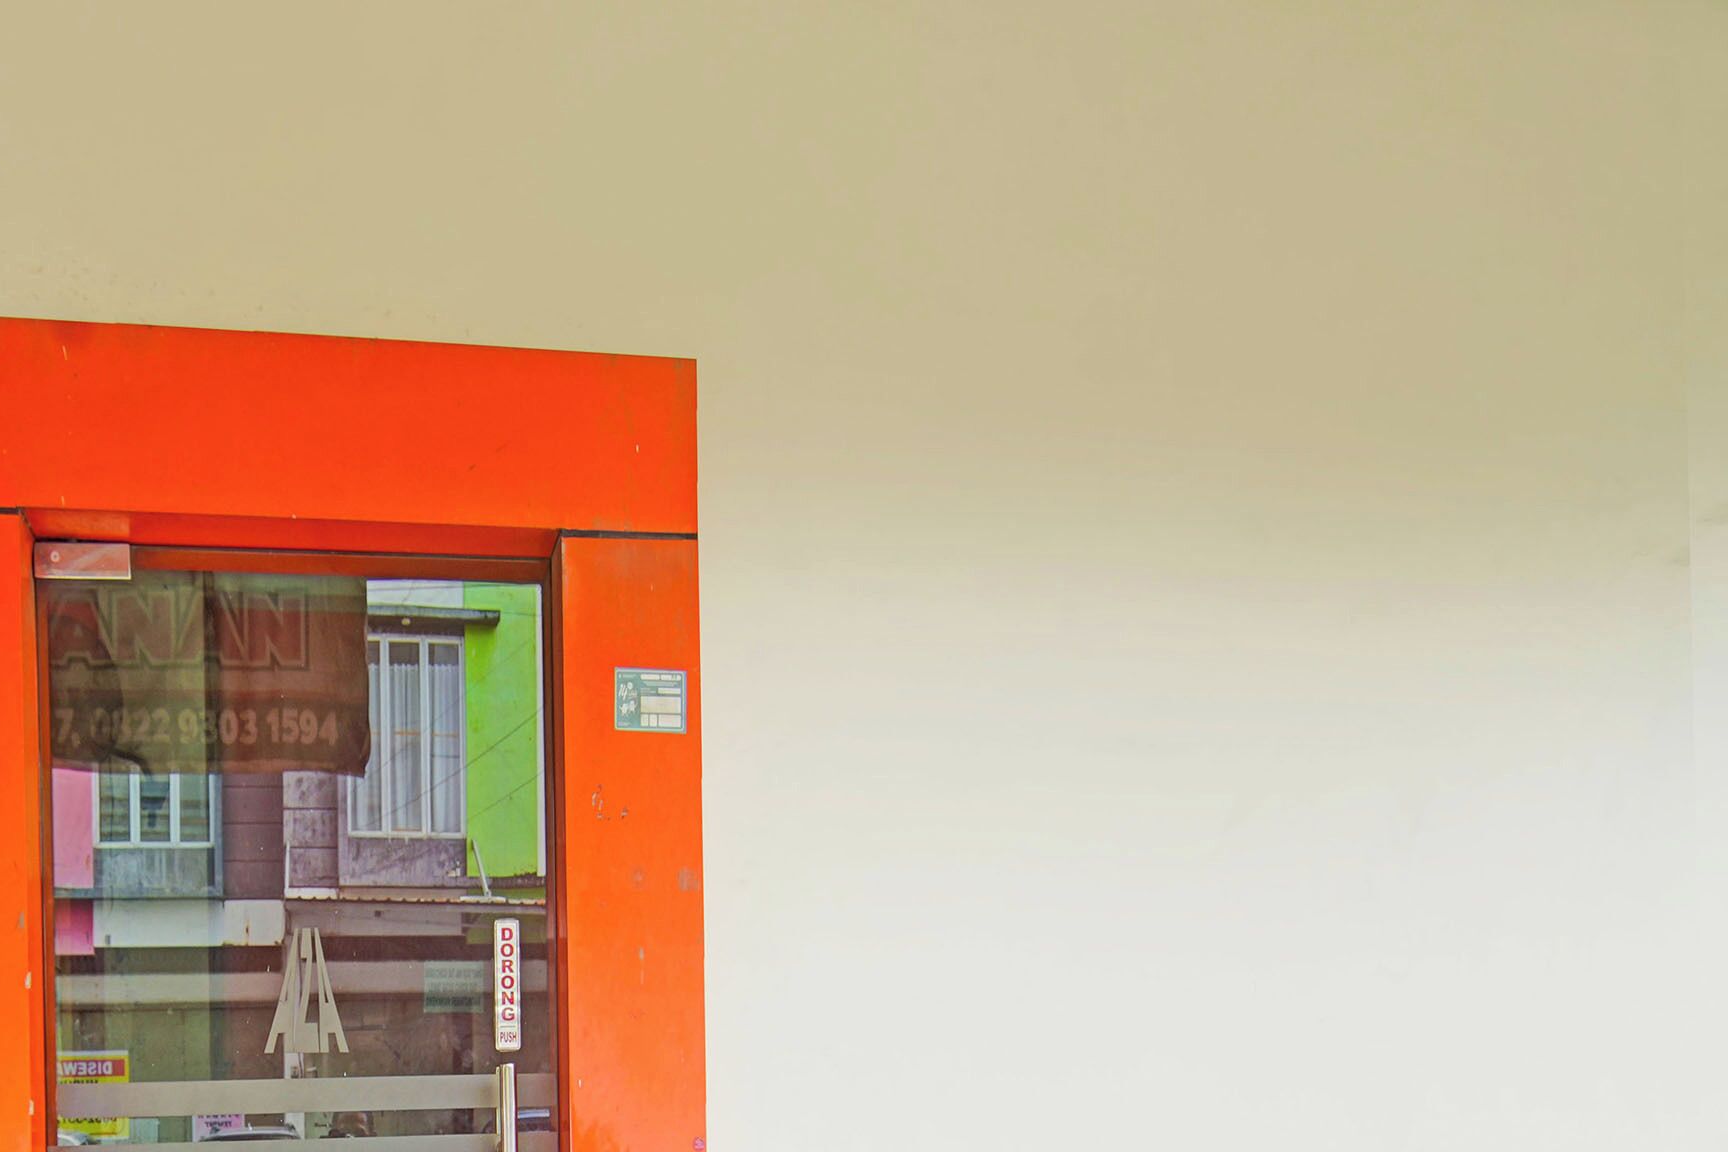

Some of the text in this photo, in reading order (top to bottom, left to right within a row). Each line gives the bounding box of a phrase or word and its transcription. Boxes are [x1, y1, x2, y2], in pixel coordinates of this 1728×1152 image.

[266, 708, 339, 746] 1594
[500, 927, 515, 1021] DORONG
[499, 1031, 517, 1043] PUSH
